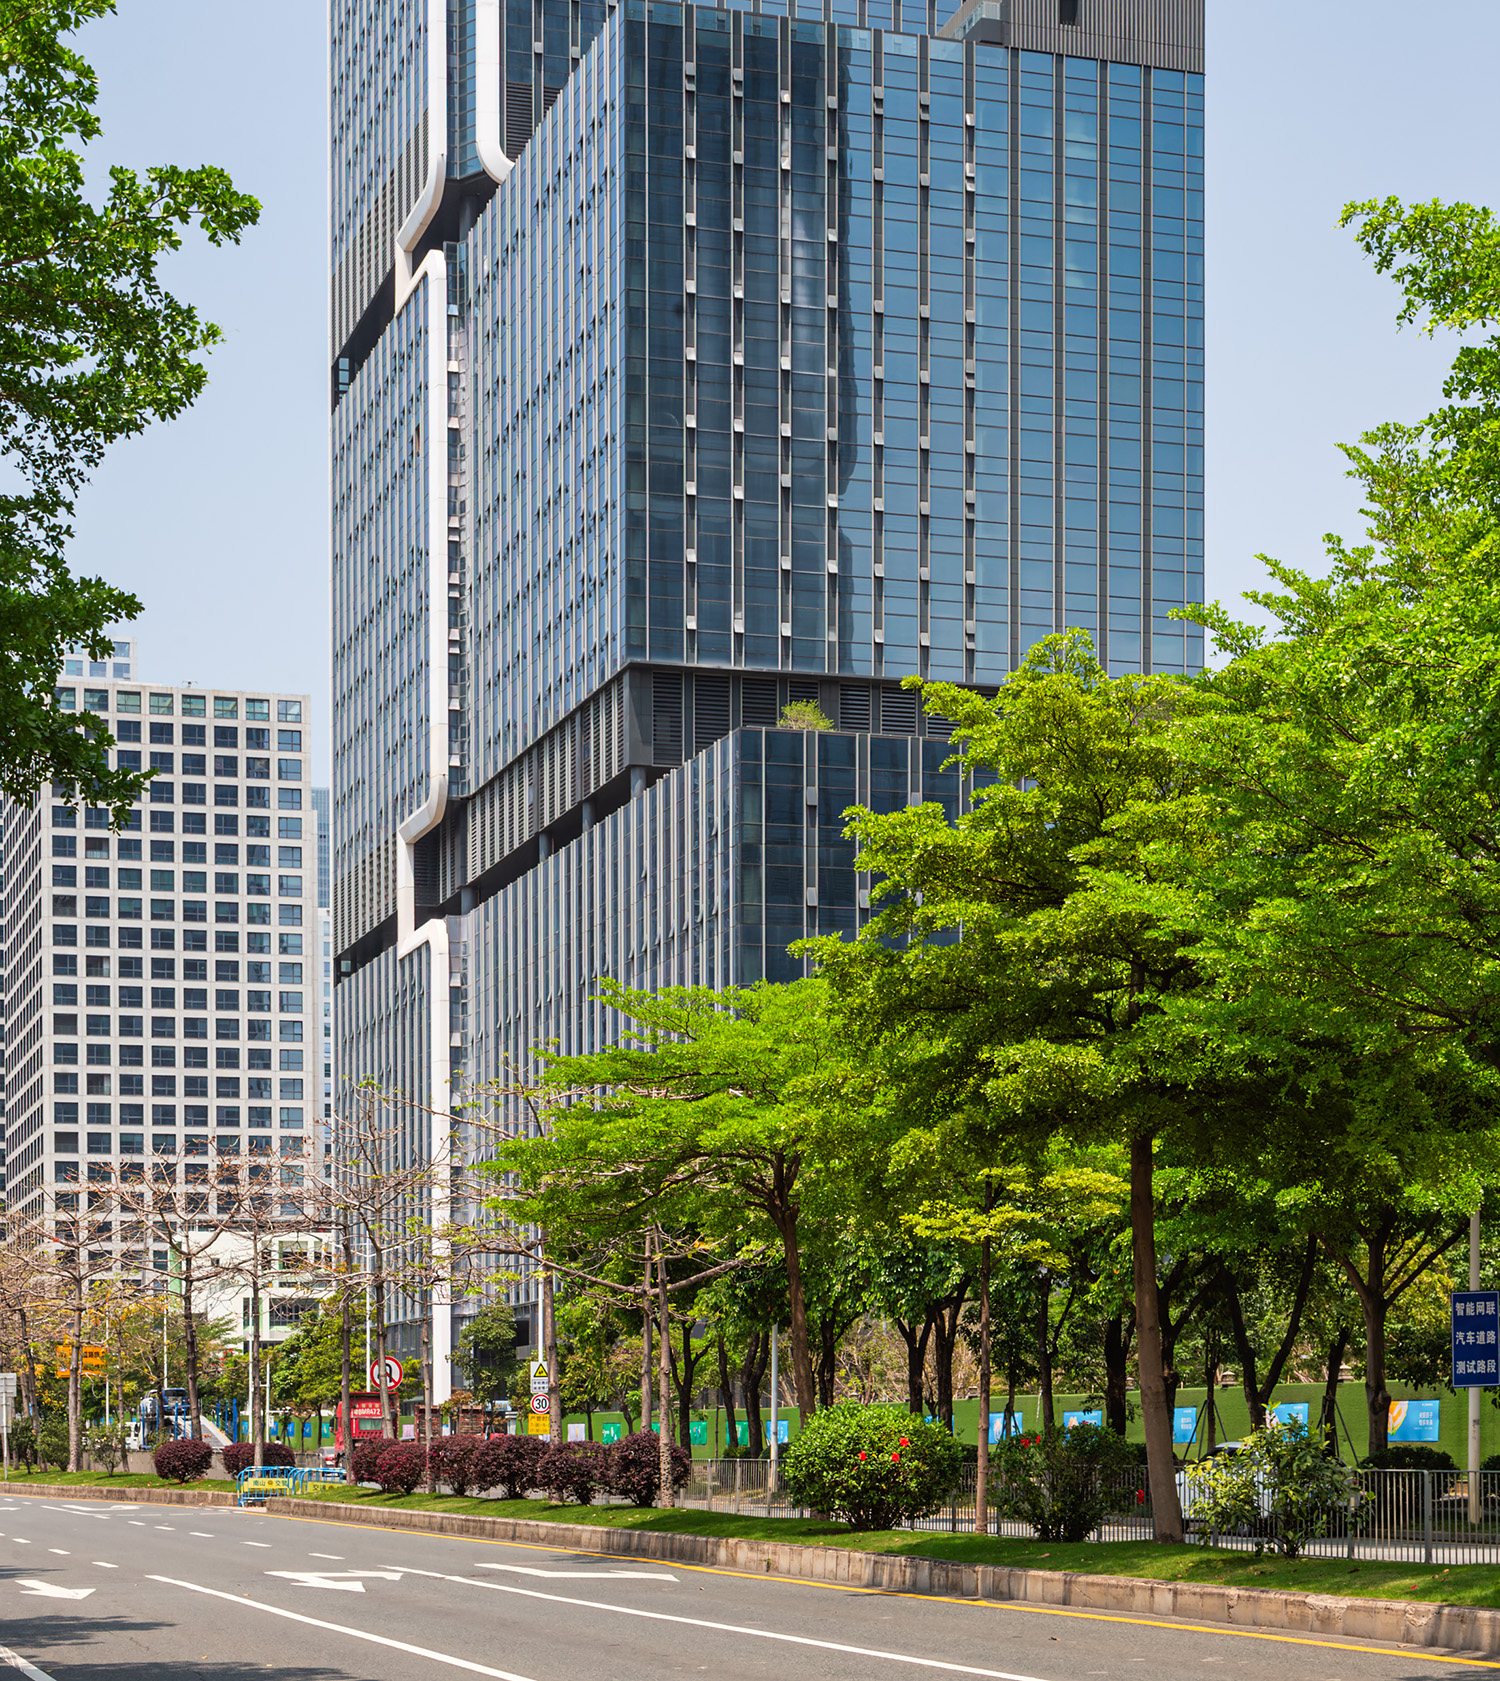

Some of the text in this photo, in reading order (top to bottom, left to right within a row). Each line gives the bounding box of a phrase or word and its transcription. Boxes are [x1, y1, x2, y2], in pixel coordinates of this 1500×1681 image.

[1455, 1301, 1496, 1316] 智能网联
[1455, 1330, 1496, 1345] 汽车道路
[1455, 1359, 1497, 1374] 测试路段
[535, 1398, 547, 1409] 30
